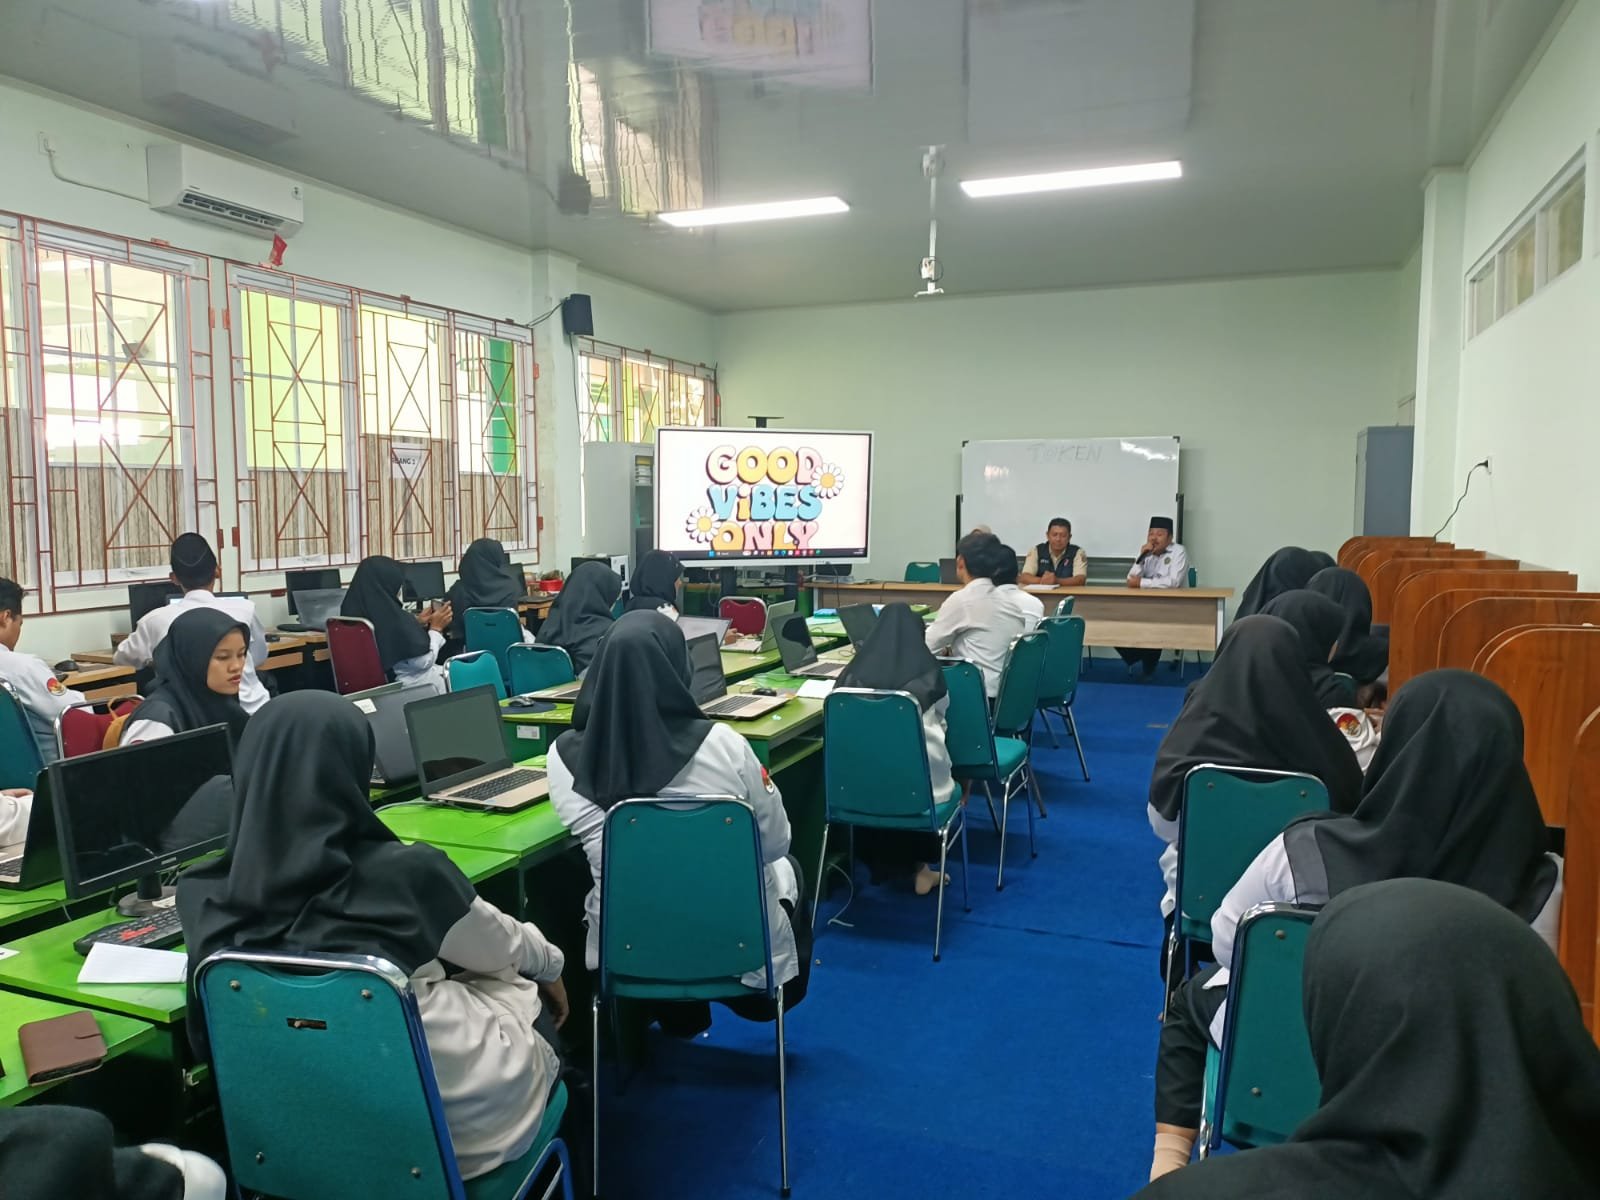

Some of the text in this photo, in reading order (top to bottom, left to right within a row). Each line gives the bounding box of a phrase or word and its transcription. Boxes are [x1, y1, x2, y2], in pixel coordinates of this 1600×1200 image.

[706, 445, 823, 484] GOOD
[1028, 443, 1102, 463] TOKEN
[710, 521, 820, 550] ONLY
